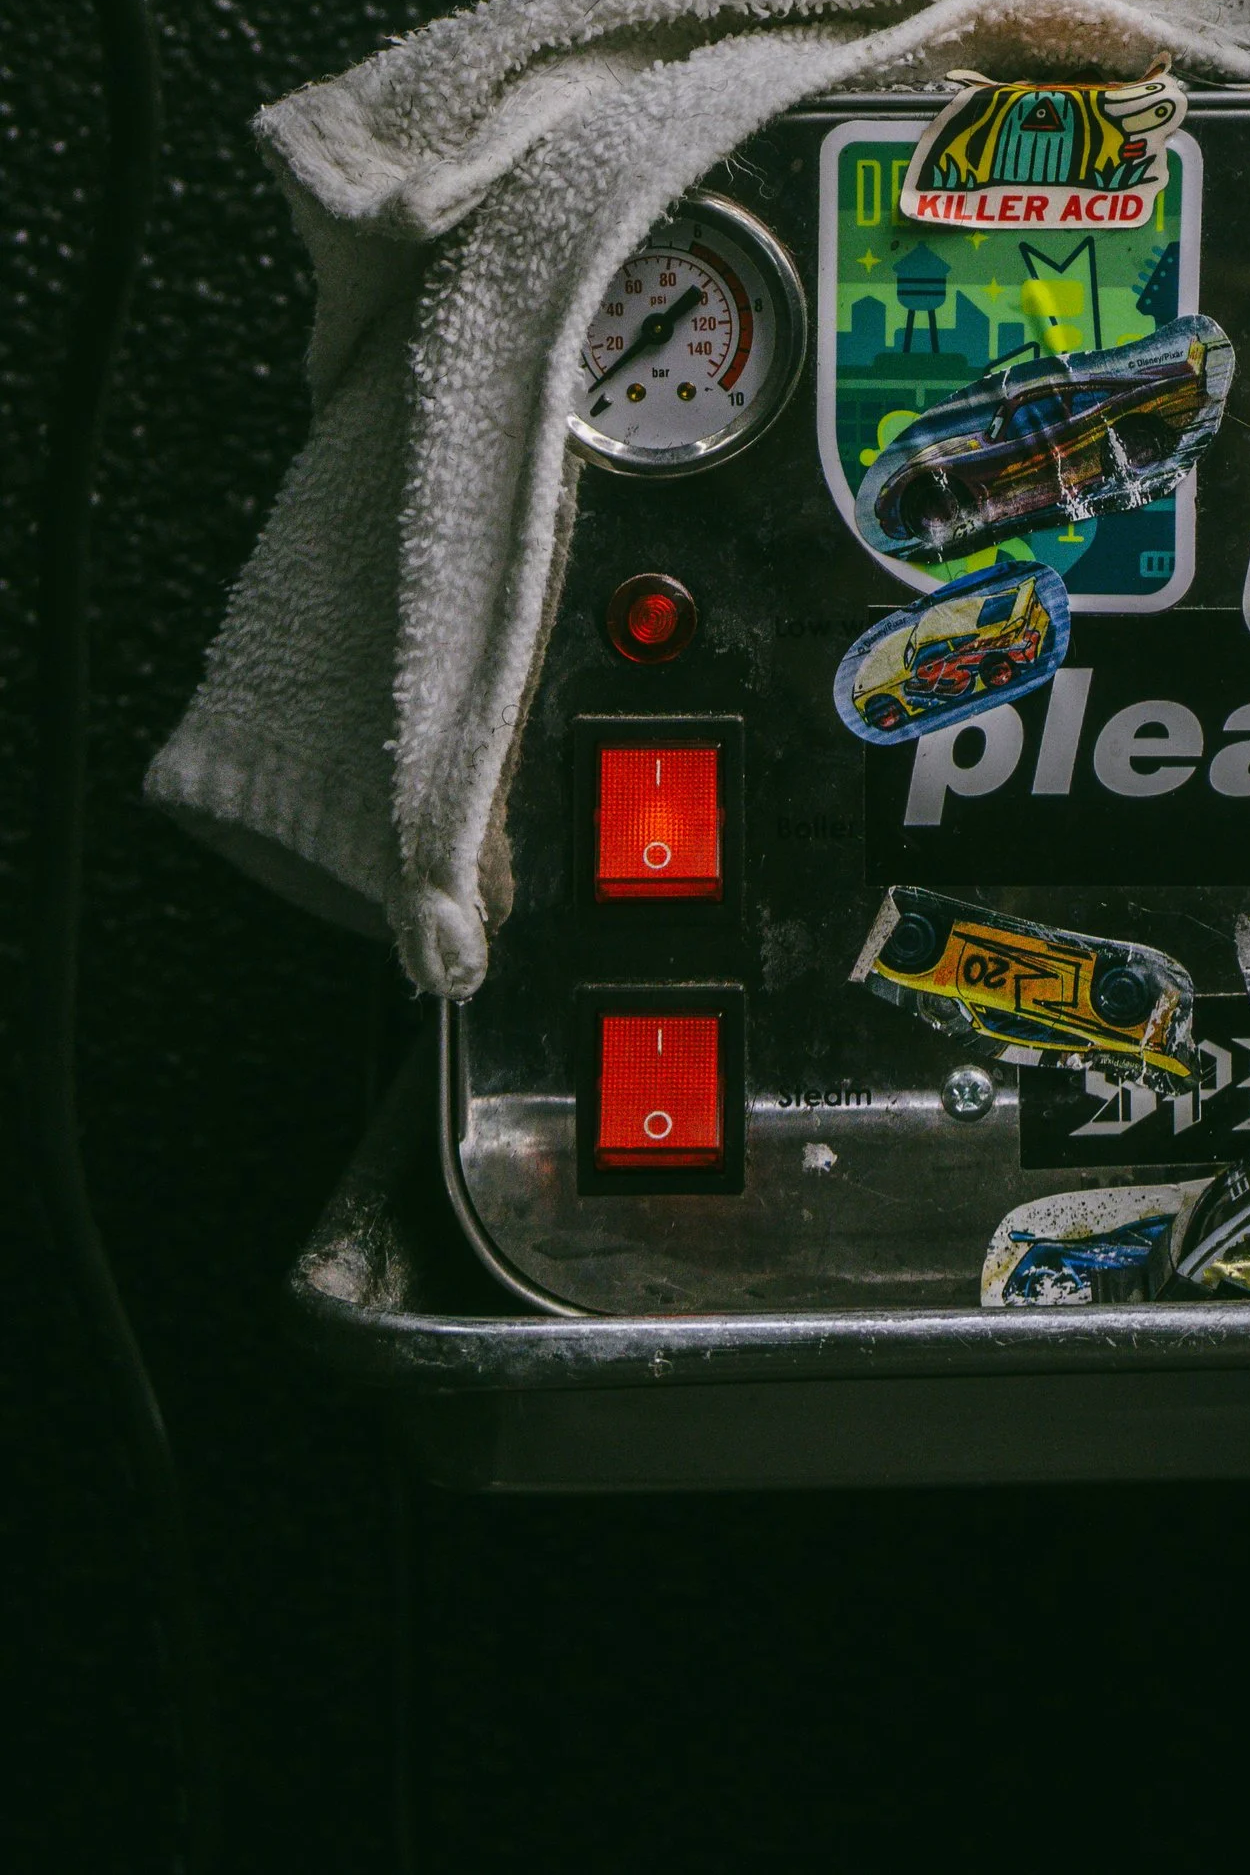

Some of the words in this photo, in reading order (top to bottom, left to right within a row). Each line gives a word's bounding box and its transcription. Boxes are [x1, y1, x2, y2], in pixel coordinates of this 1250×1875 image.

[917, 193, 1049, 222] KILLER
[1060, 193, 1145, 221] ACID
[624, 278, 643, 295] 60
[659, 272, 677, 287] 80
[650, 294, 667, 307] psi
[754, 297, 764, 313] 8
[605, 301, 624, 317] 40
[691, 317, 717, 332] 120
[606, 335, 624, 351] 20
[687, 341, 713, 356] 140
[652, 367, 670, 379] bar
[728, 391, 745, 407] 10
[962, 954, 1012, 990] 20
[778, 1083, 873, 1109] Steam
